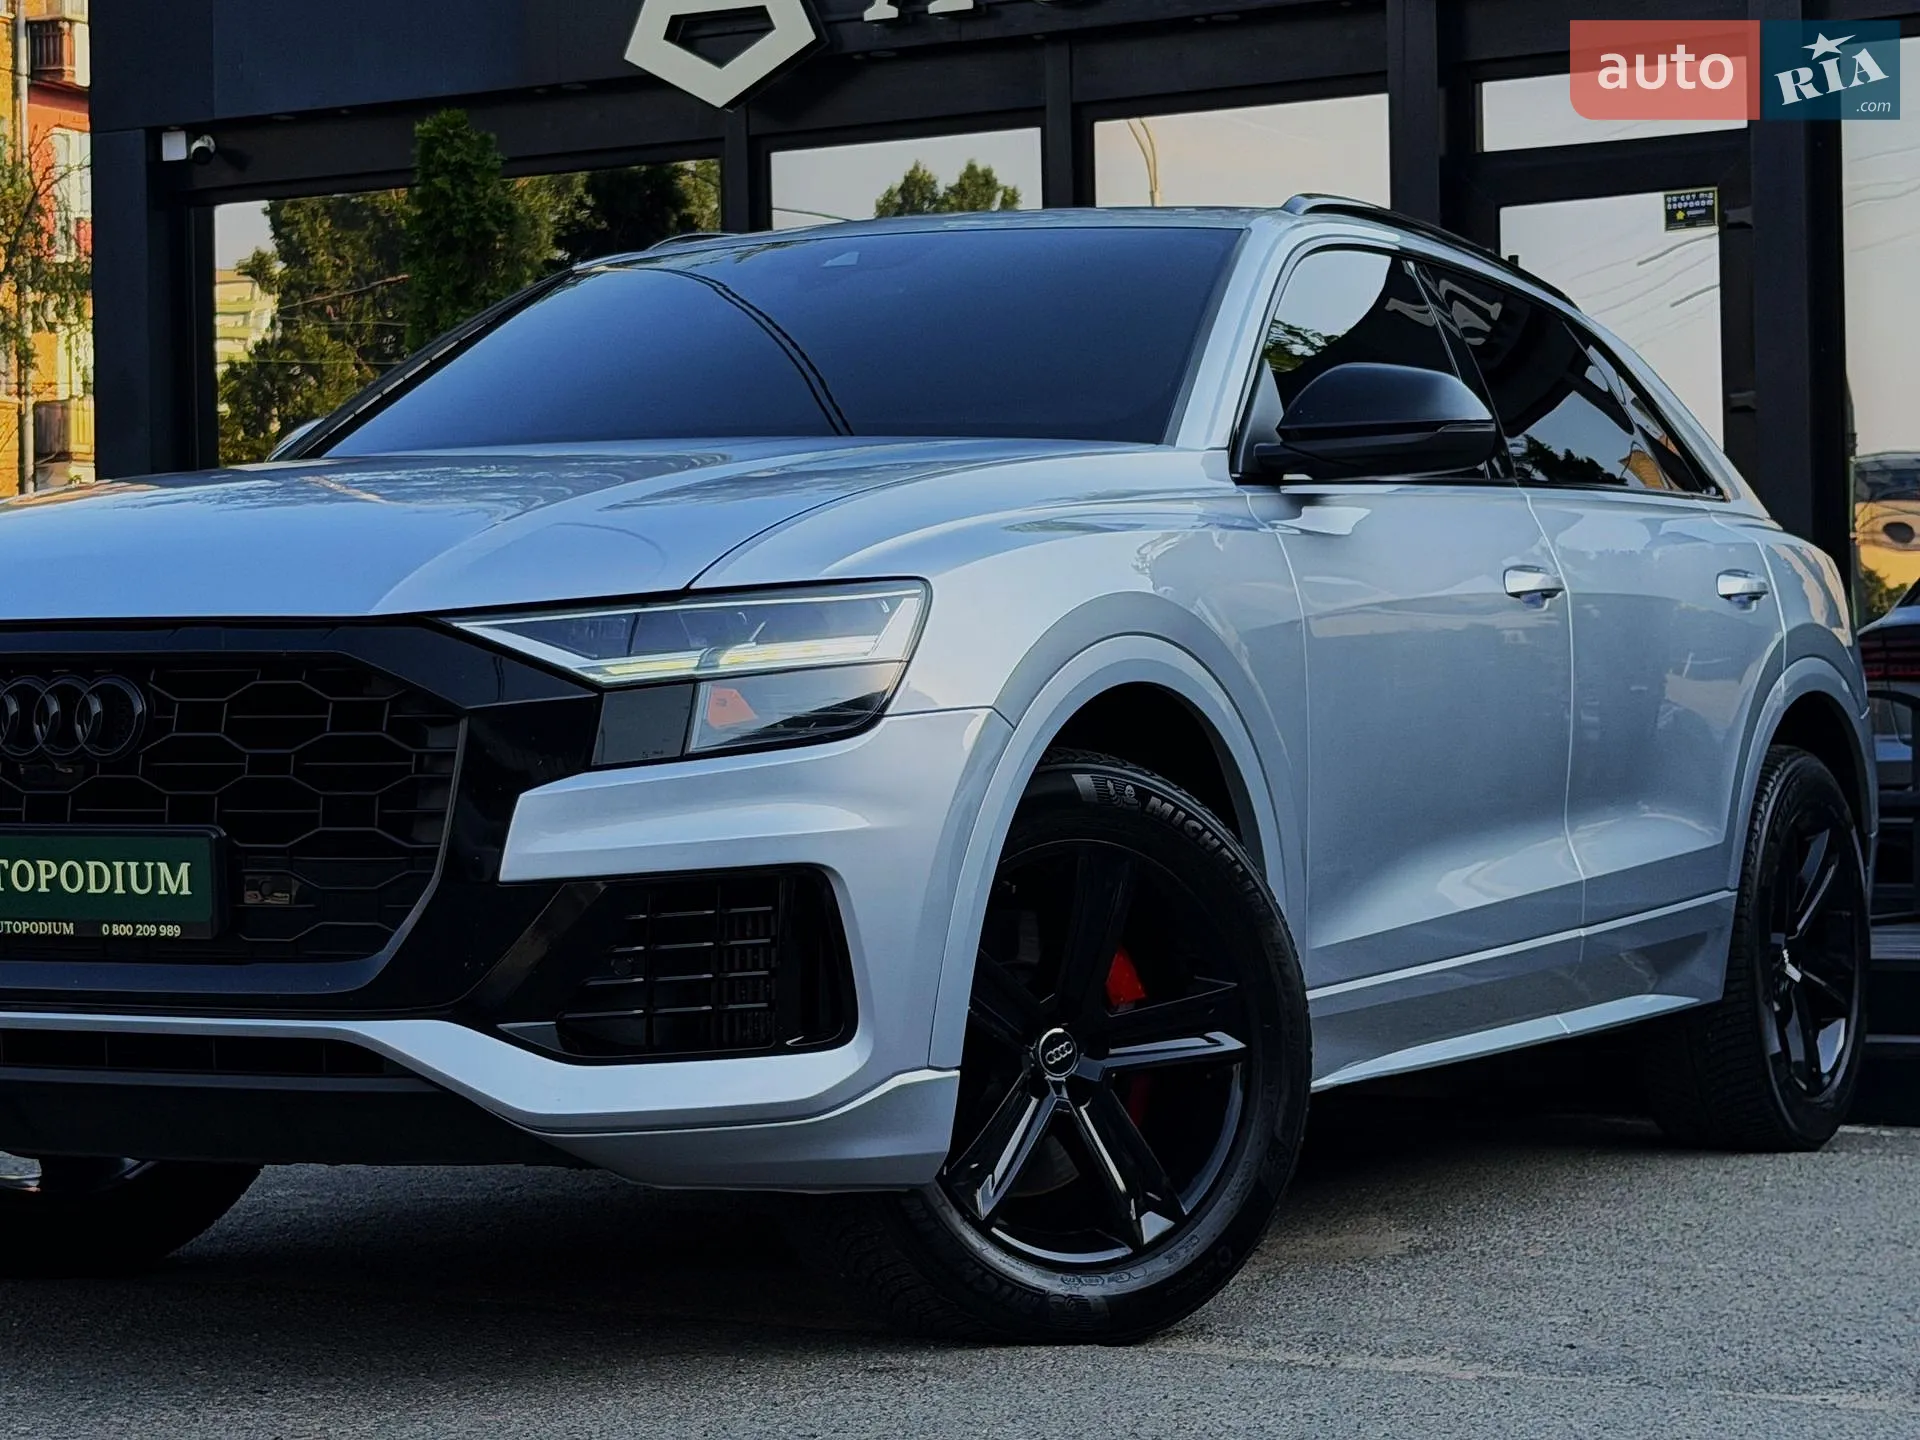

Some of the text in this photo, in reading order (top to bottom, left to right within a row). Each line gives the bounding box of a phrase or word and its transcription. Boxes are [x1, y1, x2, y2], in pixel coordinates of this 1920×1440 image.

[102, 924, 110, 936] 0
[112, 924, 133, 936] 800
[136, 924, 157, 937] 209
[159, 924, 181, 937] 989
